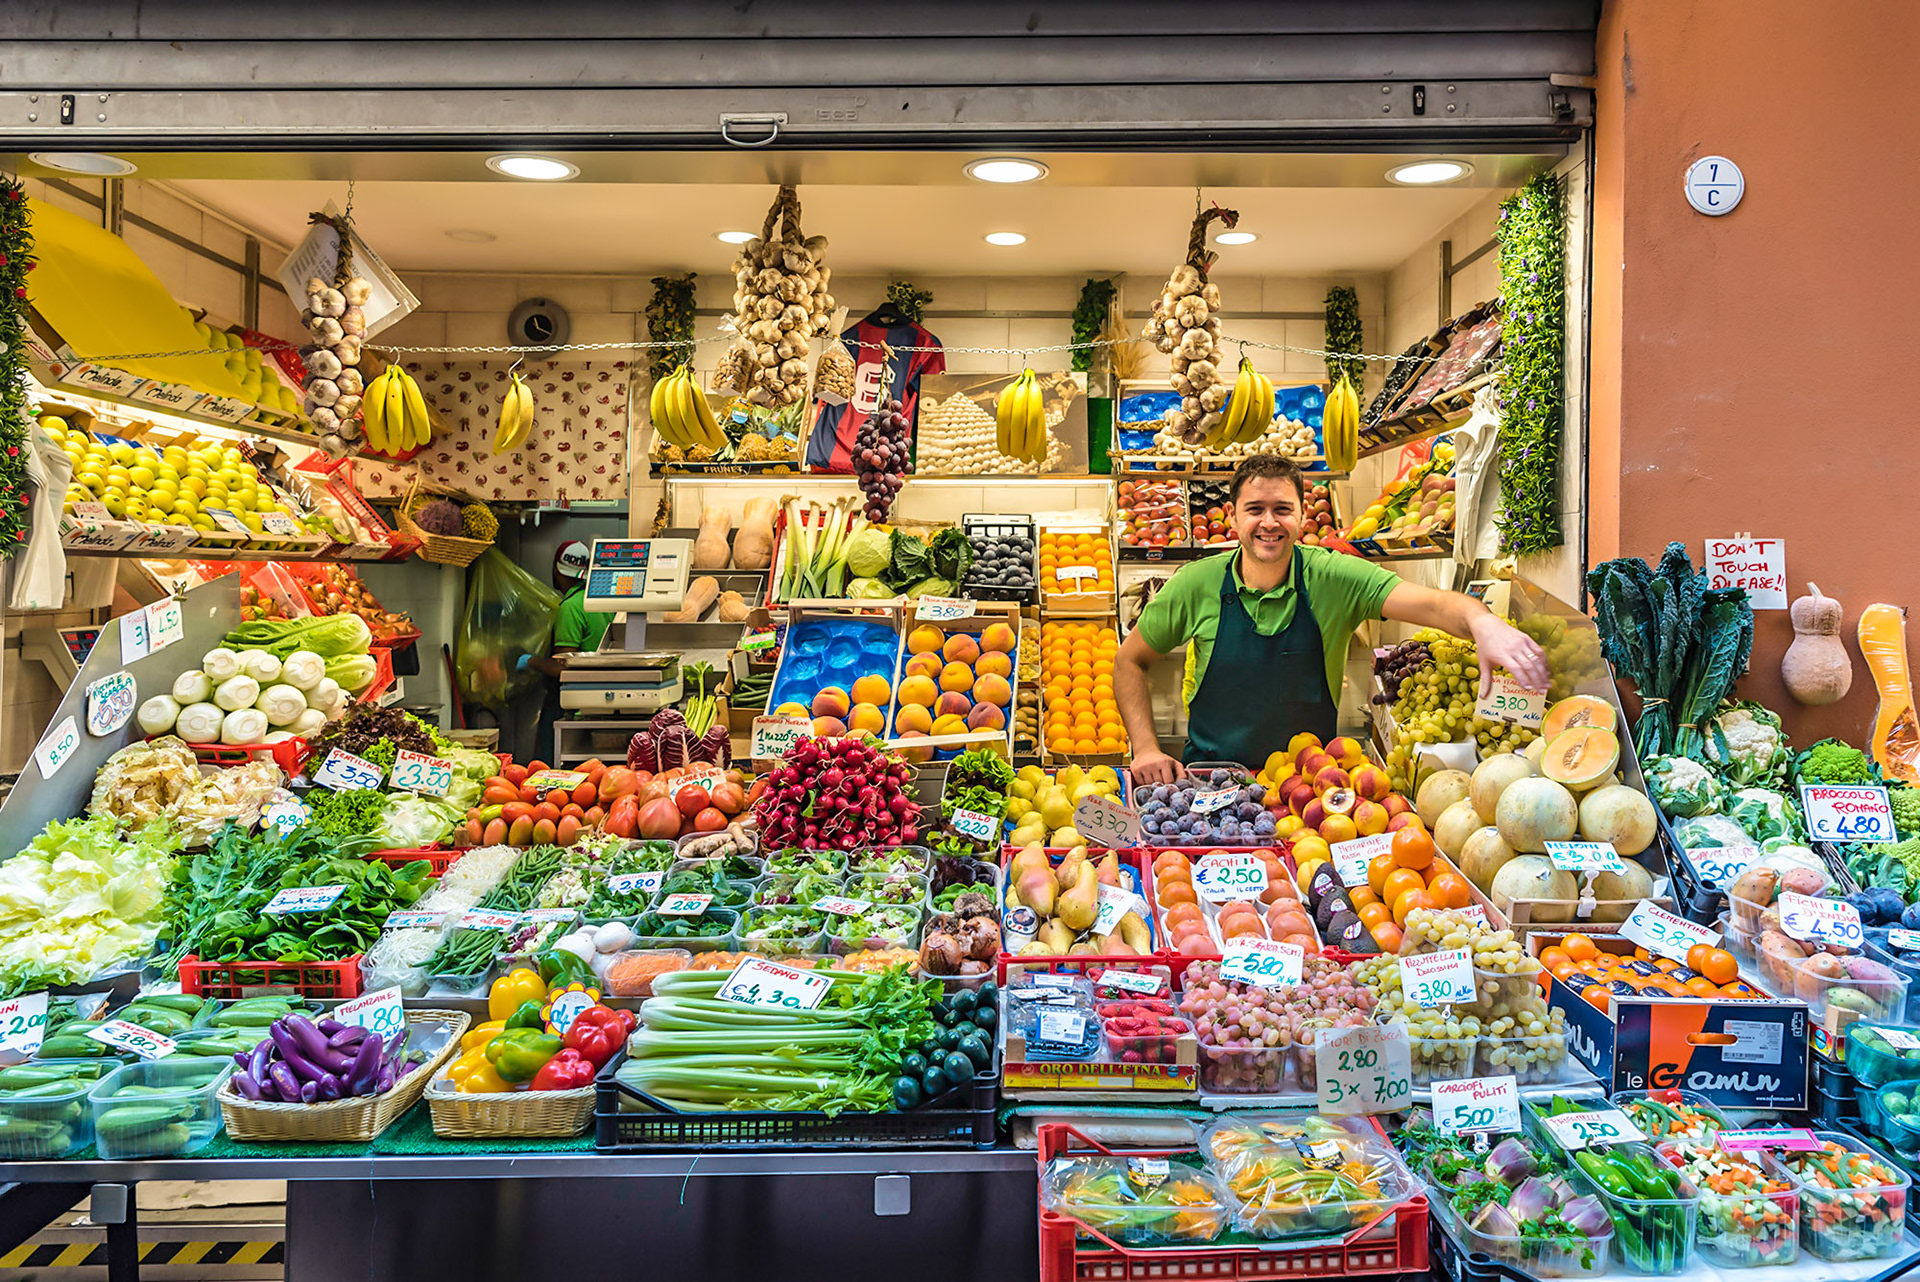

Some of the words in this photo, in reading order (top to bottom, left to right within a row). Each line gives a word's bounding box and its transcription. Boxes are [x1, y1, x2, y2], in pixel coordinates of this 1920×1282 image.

[1709, 164, 1719, 182] 7
[1708, 189, 1720, 206] C
[703, 466, 744, 474] FRUNET
[1711, 541, 1776, 558] DON'T
[1715, 561, 1769, 574] TOUCH
[1491, 696, 1528, 711] 3,80
[756, 743, 766, 756] 3
[401, 751, 453, 771] LATTUGA
[1811, 788, 1876, 801] BROCCOLO
[960, 810, 991, 823] LOLLO
[1832, 802, 1889, 814] ROMANO
[1200, 857, 1239, 868] CACHI
[1217, 868, 1263, 885] 2,50
[1785, 894, 1824, 909] FICHI
[1648, 907, 1710, 937] CLEMENTINE
[1811, 919, 1860, 939] 4,50
[1644, 922, 1698, 951] 3,80
[752, 962, 800, 980] SEDANO
[1418, 979, 1452, 1002] 3,80
[340, 991, 396, 1016] MELANZANE
[1337, 1049, 1378, 1072] 2,80
[1039, 1063, 1074, 1076] ORO
[1078, 1063, 1161, 1076] DELL'ETNA
[1629, 1073, 1644, 1089] le
[1649, 1062, 1781, 1093] Gamin
[1326, 1079, 1344, 1104] 3
[1373, 1076, 1409, 1104] 7,00
[1438, 1080, 1484, 1094] CARCIOFI
[1472, 1082, 1508, 1101] PULITI
[1454, 1105, 1494, 1128] 5,00
[1572, 1122, 1620, 1140] 2,50
